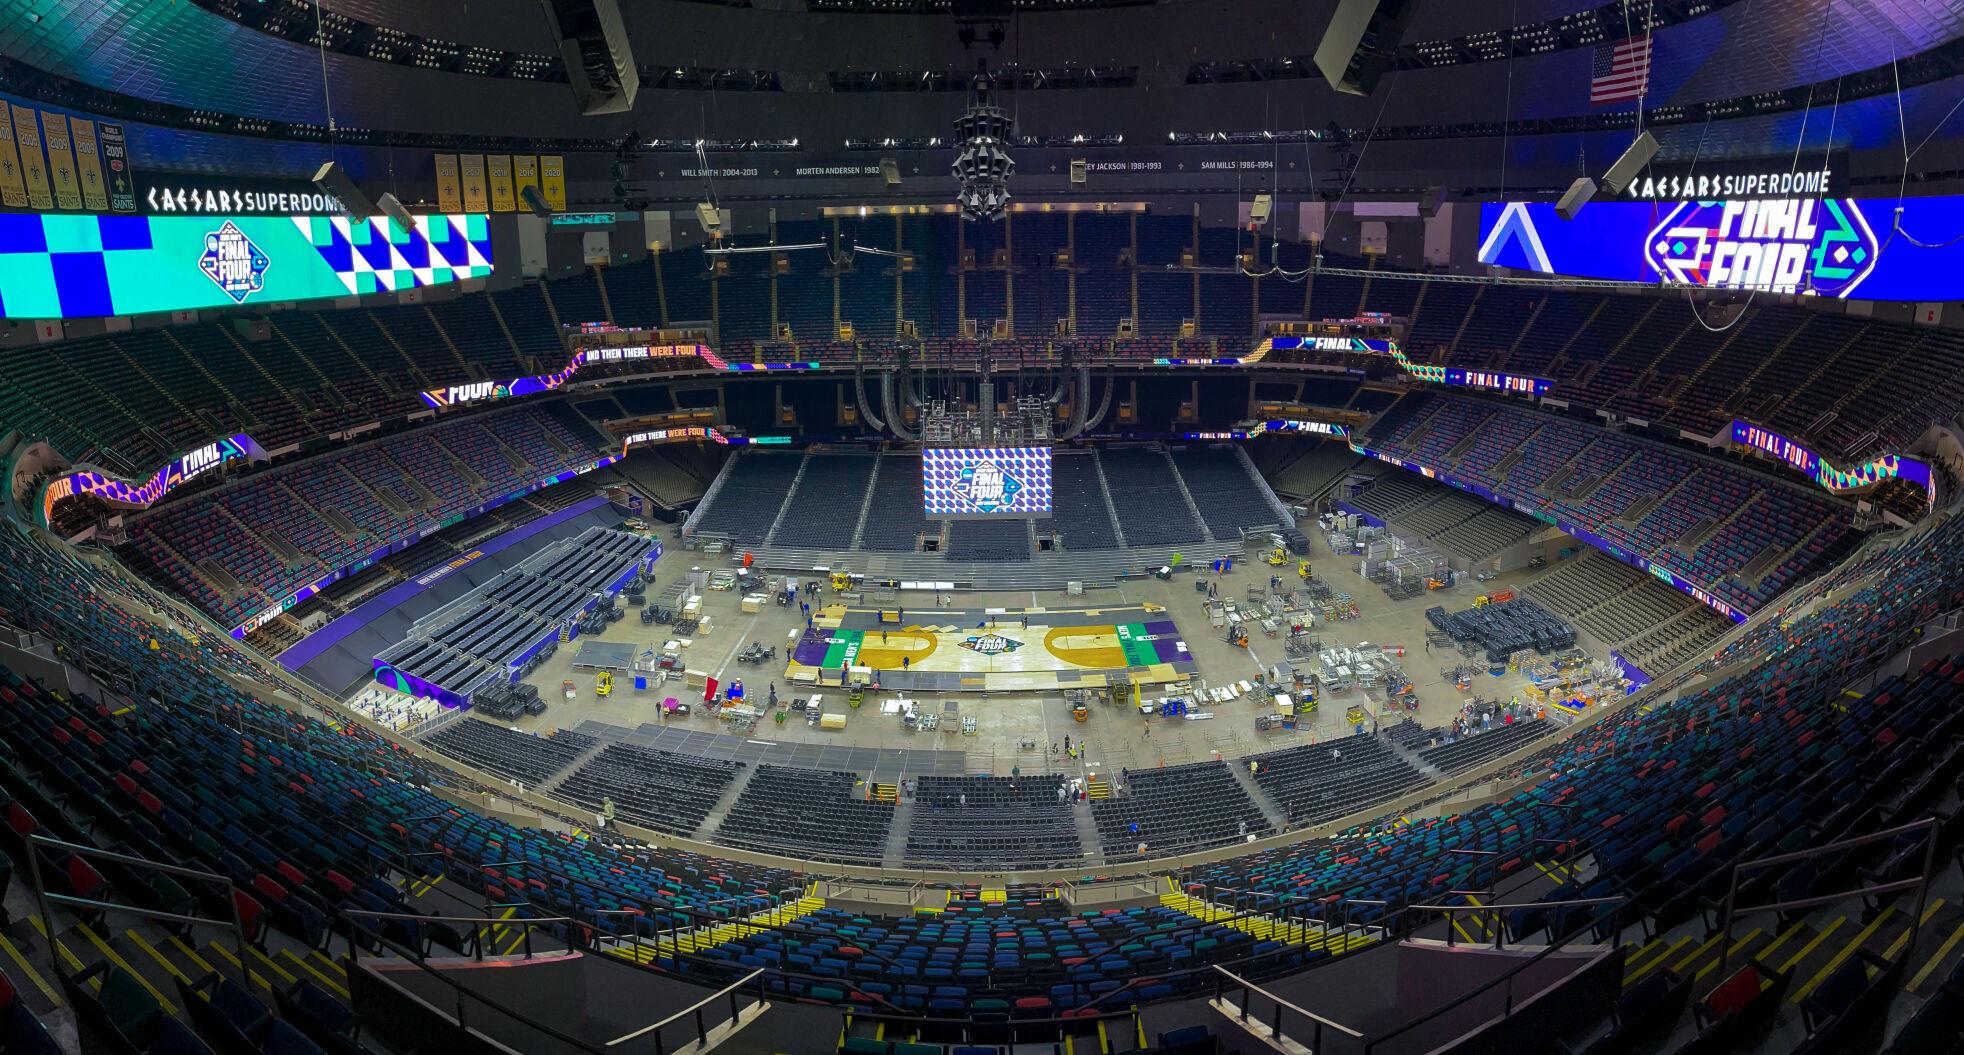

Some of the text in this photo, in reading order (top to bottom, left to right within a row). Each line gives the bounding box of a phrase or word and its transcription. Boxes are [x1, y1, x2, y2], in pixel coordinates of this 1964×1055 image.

[49, 136, 68, 150] 2009
[106, 144, 124, 158] 2009
[796, 167, 824, 175] MORTEN
[1096, 162, 1126, 170] JACKSON
[1130, 162, 1162, 170] 1981-1993
[1201, 161, 1273, 169] SAM MILLS 1986-1994
[697, 169, 718, 177] SMITH
[722, 168, 758, 176] 2004-2013
[1628, 171, 1832, 198] CAESARS SUPERDOME
[113, 199, 134, 210] SAINTS
[147, 187, 244, 213] CAESARS
[1719, 199, 1818, 240] FINAL
[218, 240, 251, 260] FINAL
[219, 260, 251, 281] FOUR
[1315, 337, 1353, 350] FINAL
[601, 348, 622, 359] THEN
[623, 347, 648, 358] THERE
[649, 346, 674, 357] WERE
[675, 345, 697, 356] FOUR
[1465, 371, 1534, 393] FINAL FOUR
[647, 430, 667, 440] THERE
[667, 429, 687, 438] WERE
[687, 427, 706, 436] FOUR
[1298, 421, 1332, 434] FINAL
[1748, 427, 1808, 470] FINAL FOUR
[971, 472, 1005, 486] FINAL
[970, 485, 1004, 499] FOUR
[1691, 587, 1730, 616] FINAL FOUR
